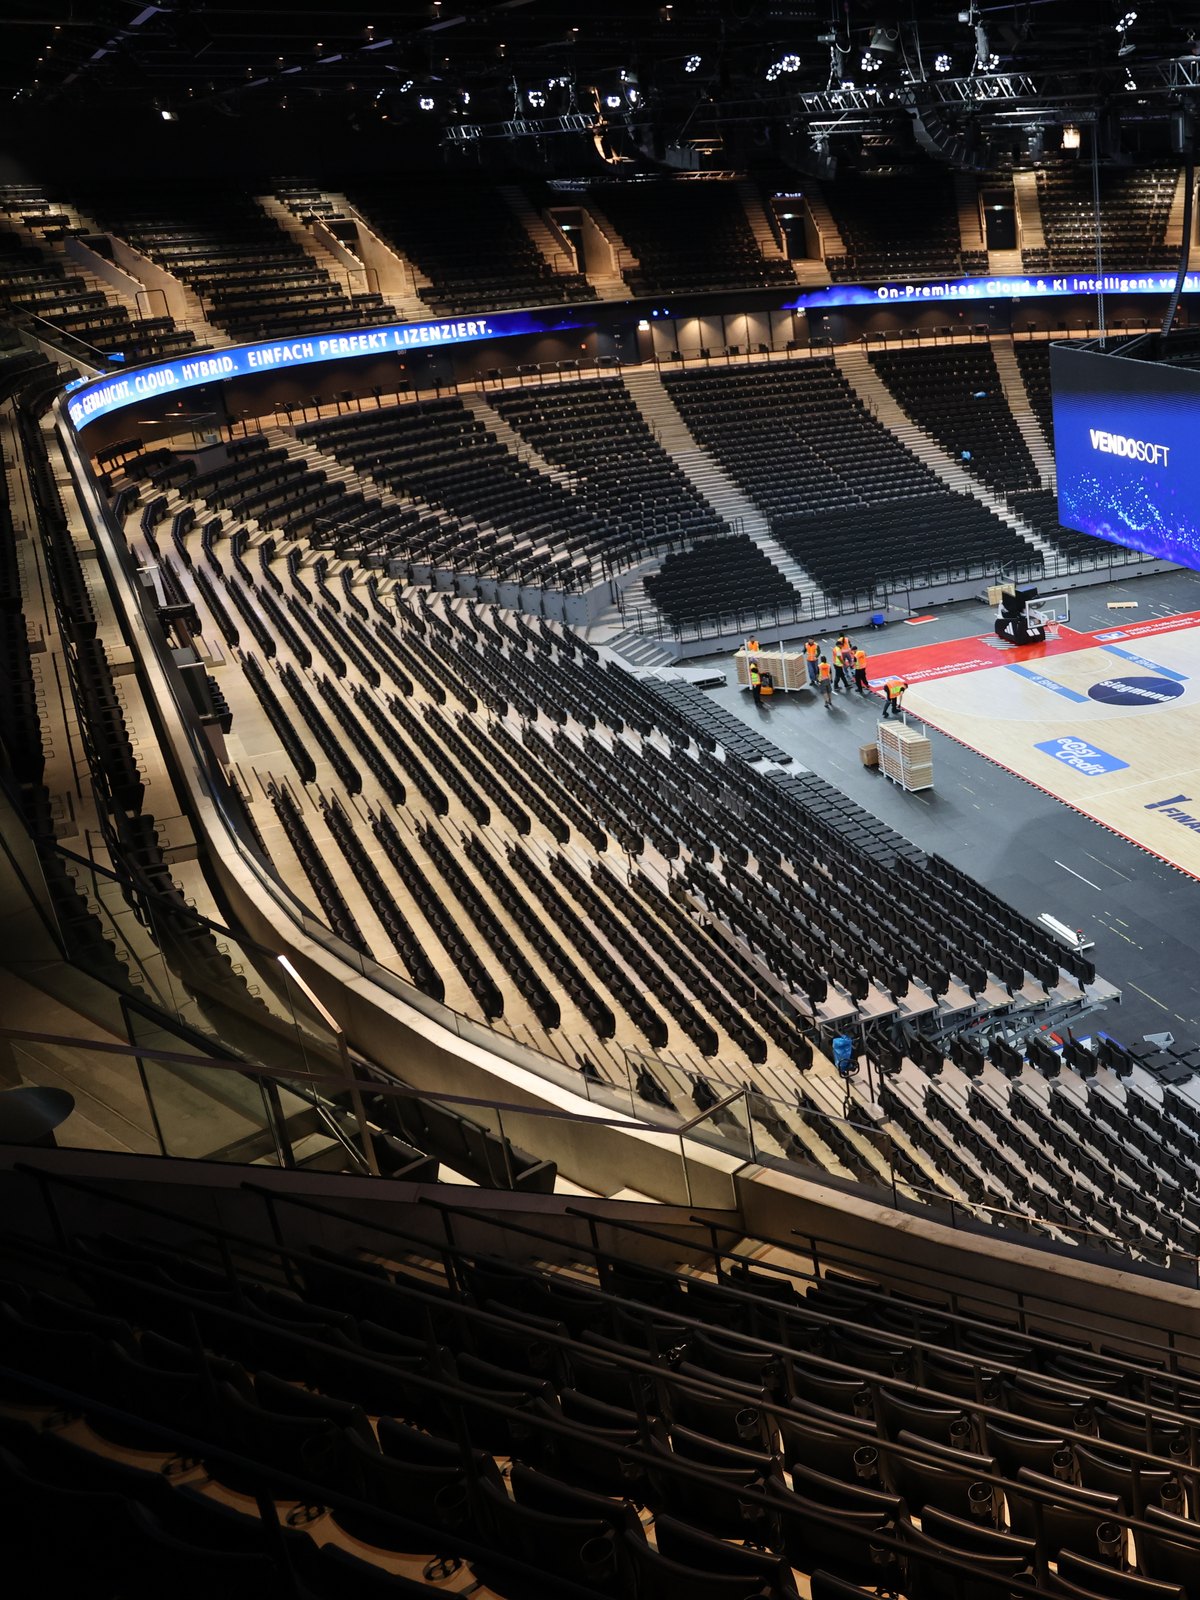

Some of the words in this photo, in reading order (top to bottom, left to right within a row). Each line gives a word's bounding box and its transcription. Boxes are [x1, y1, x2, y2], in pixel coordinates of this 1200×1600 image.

[877, 283, 980, 300] On-Premises,
[986, 280, 1030, 295] Cloud
[1036, 279, 1047, 292] &
[1053, 278, 1068, 291] KI
[1073, 276, 1154, 292] intelligent
[134, 370, 180, 394] CLOUD.
[181, 355, 239, 381] HYBRID.
[247, 342, 315, 368] EINFACH
[318, 331, 389, 356] PERFEKT
[393, 320, 493, 346] LIZENZIERT.
[1089, 428, 1170, 468] VENDOSOFT
[1099, 679, 1177, 702] siegmund
